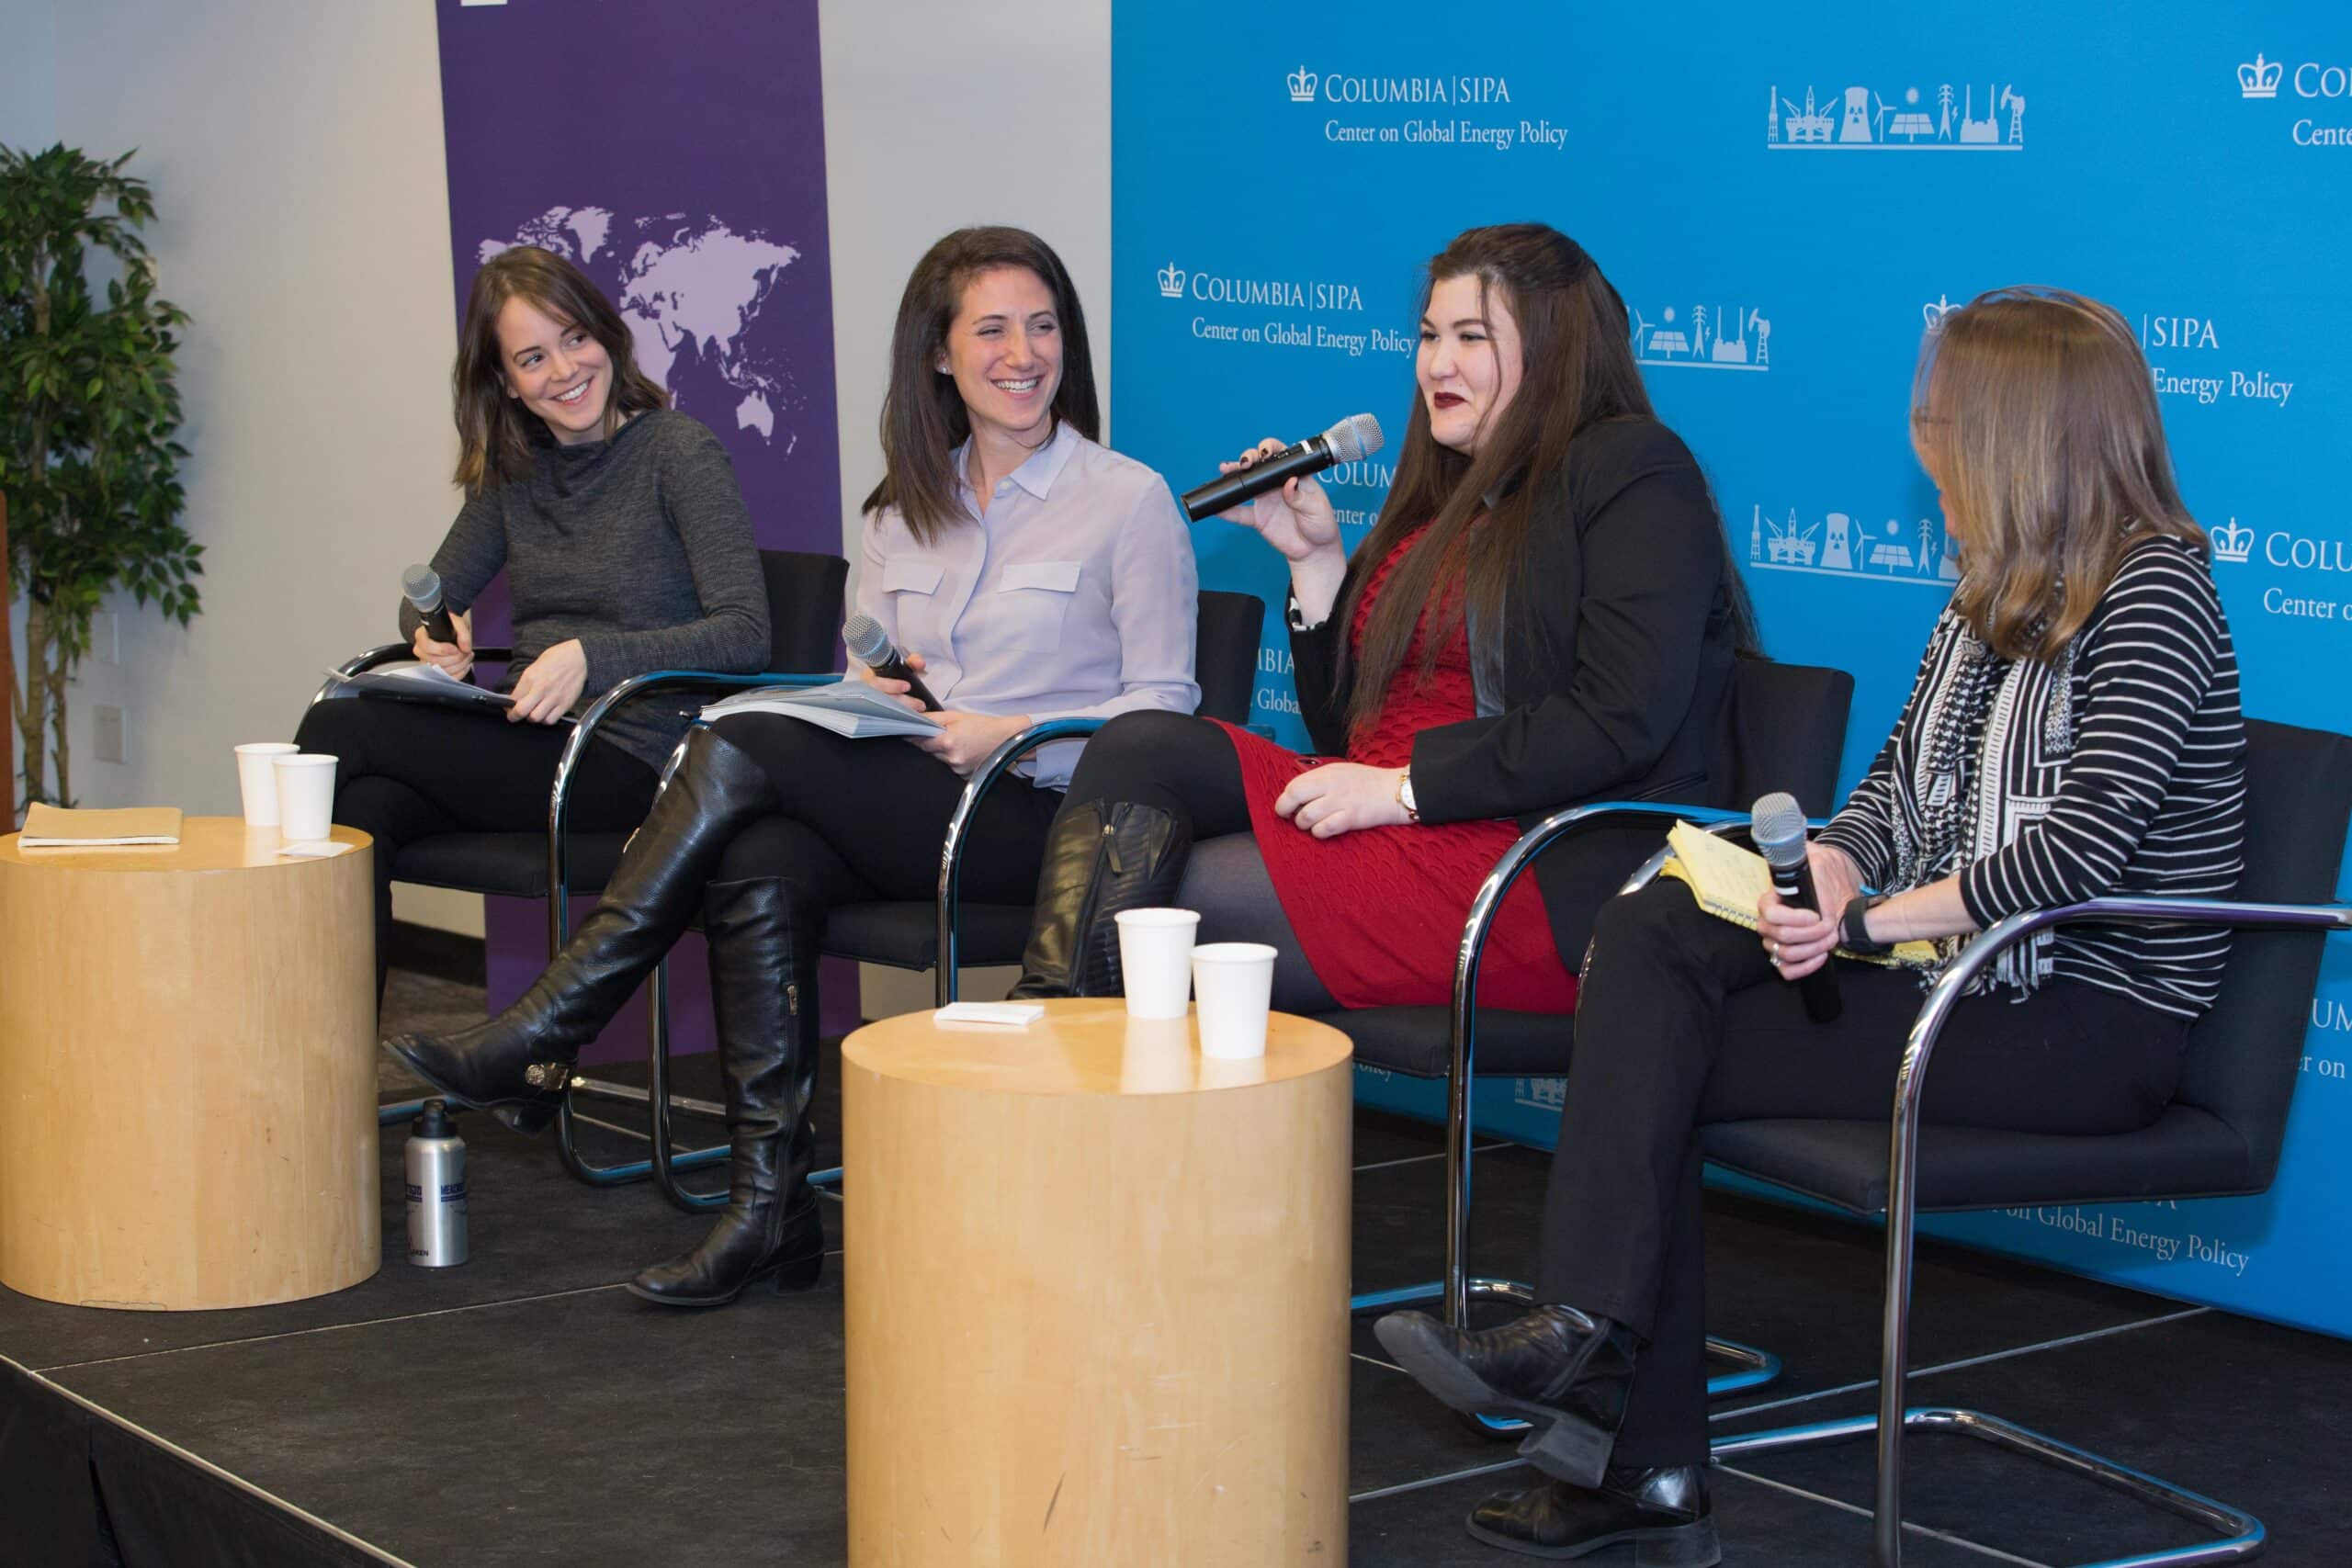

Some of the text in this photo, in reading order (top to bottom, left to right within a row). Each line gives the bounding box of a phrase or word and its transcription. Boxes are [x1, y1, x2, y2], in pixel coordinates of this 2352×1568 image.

[2294, 62, 2352, 97] CO
[1325, 119, 1568, 151] Center on Global Energy Policy
[1193, 317, 1416, 359] Center on Global Energy Policy
[2153, 317, 2220, 349] SIPA
[2153, 367, 2294, 408] Energy Policy
[1334, 508, 1365, 525] nter
[2264, 588, 2336, 618] Center
[2318, 1059, 2346, 1079] on
[2038, 1207, 2103, 1238] Global
[2109, 1217, 2181, 1261] Energy
[2188, 1235, 2249, 1277] Policy
